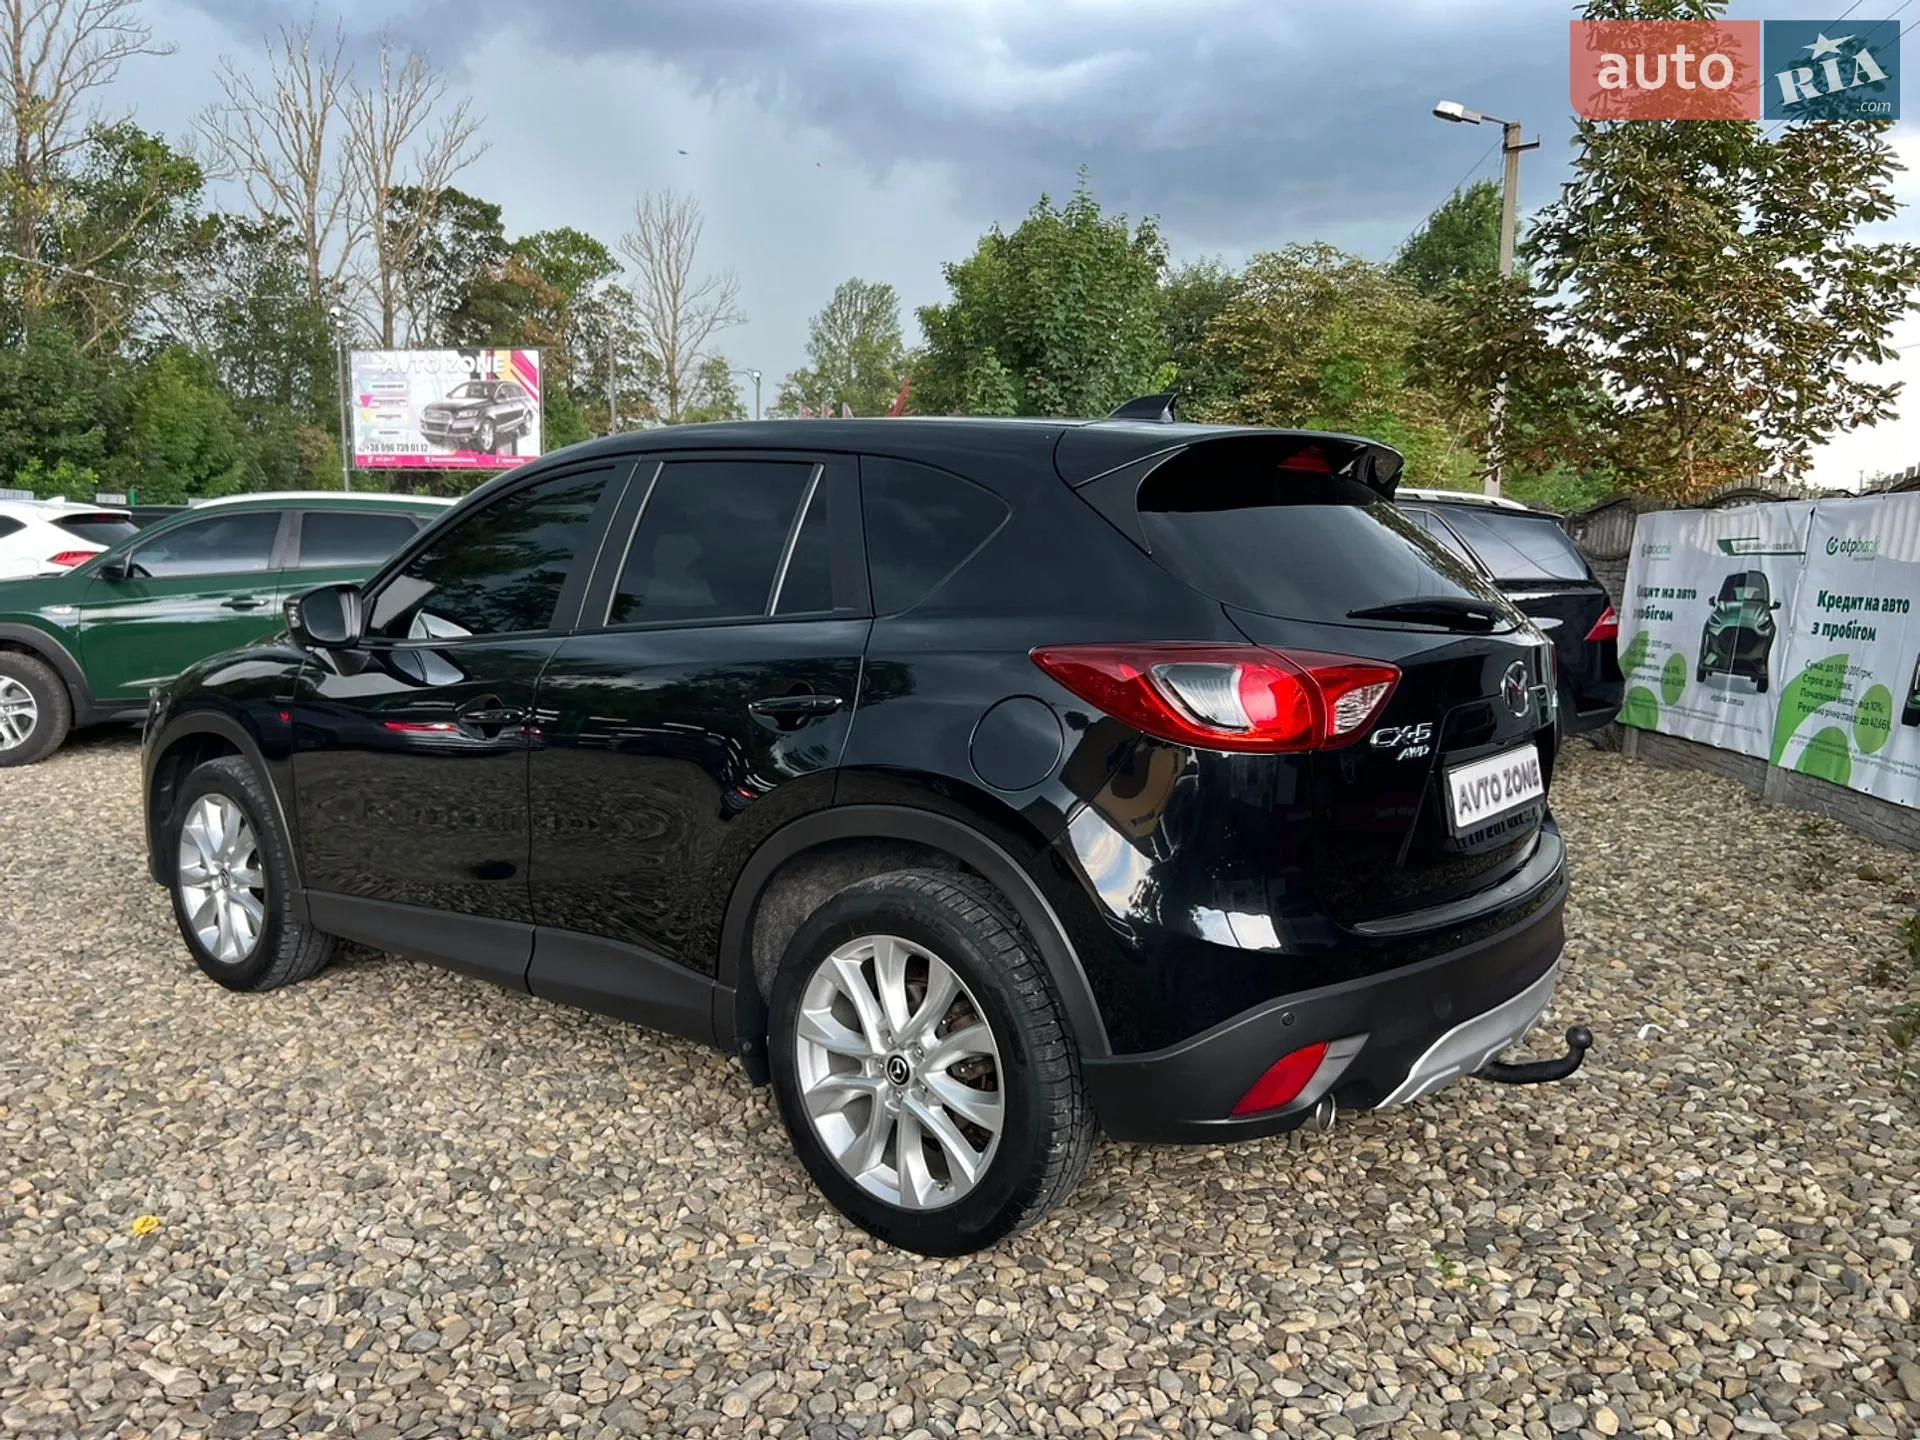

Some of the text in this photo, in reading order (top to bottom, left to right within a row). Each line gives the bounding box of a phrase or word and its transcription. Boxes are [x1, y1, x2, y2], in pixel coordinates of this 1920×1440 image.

[1817, 590, 1910, 614] Кредит на авто
[1811, 619, 1877, 642] з пробігом
[1369, 722, 1433, 748] CX-5
[1397, 746, 1430, 761] AWD
[1458, 759, 1540, 817] AVTO ZONE
